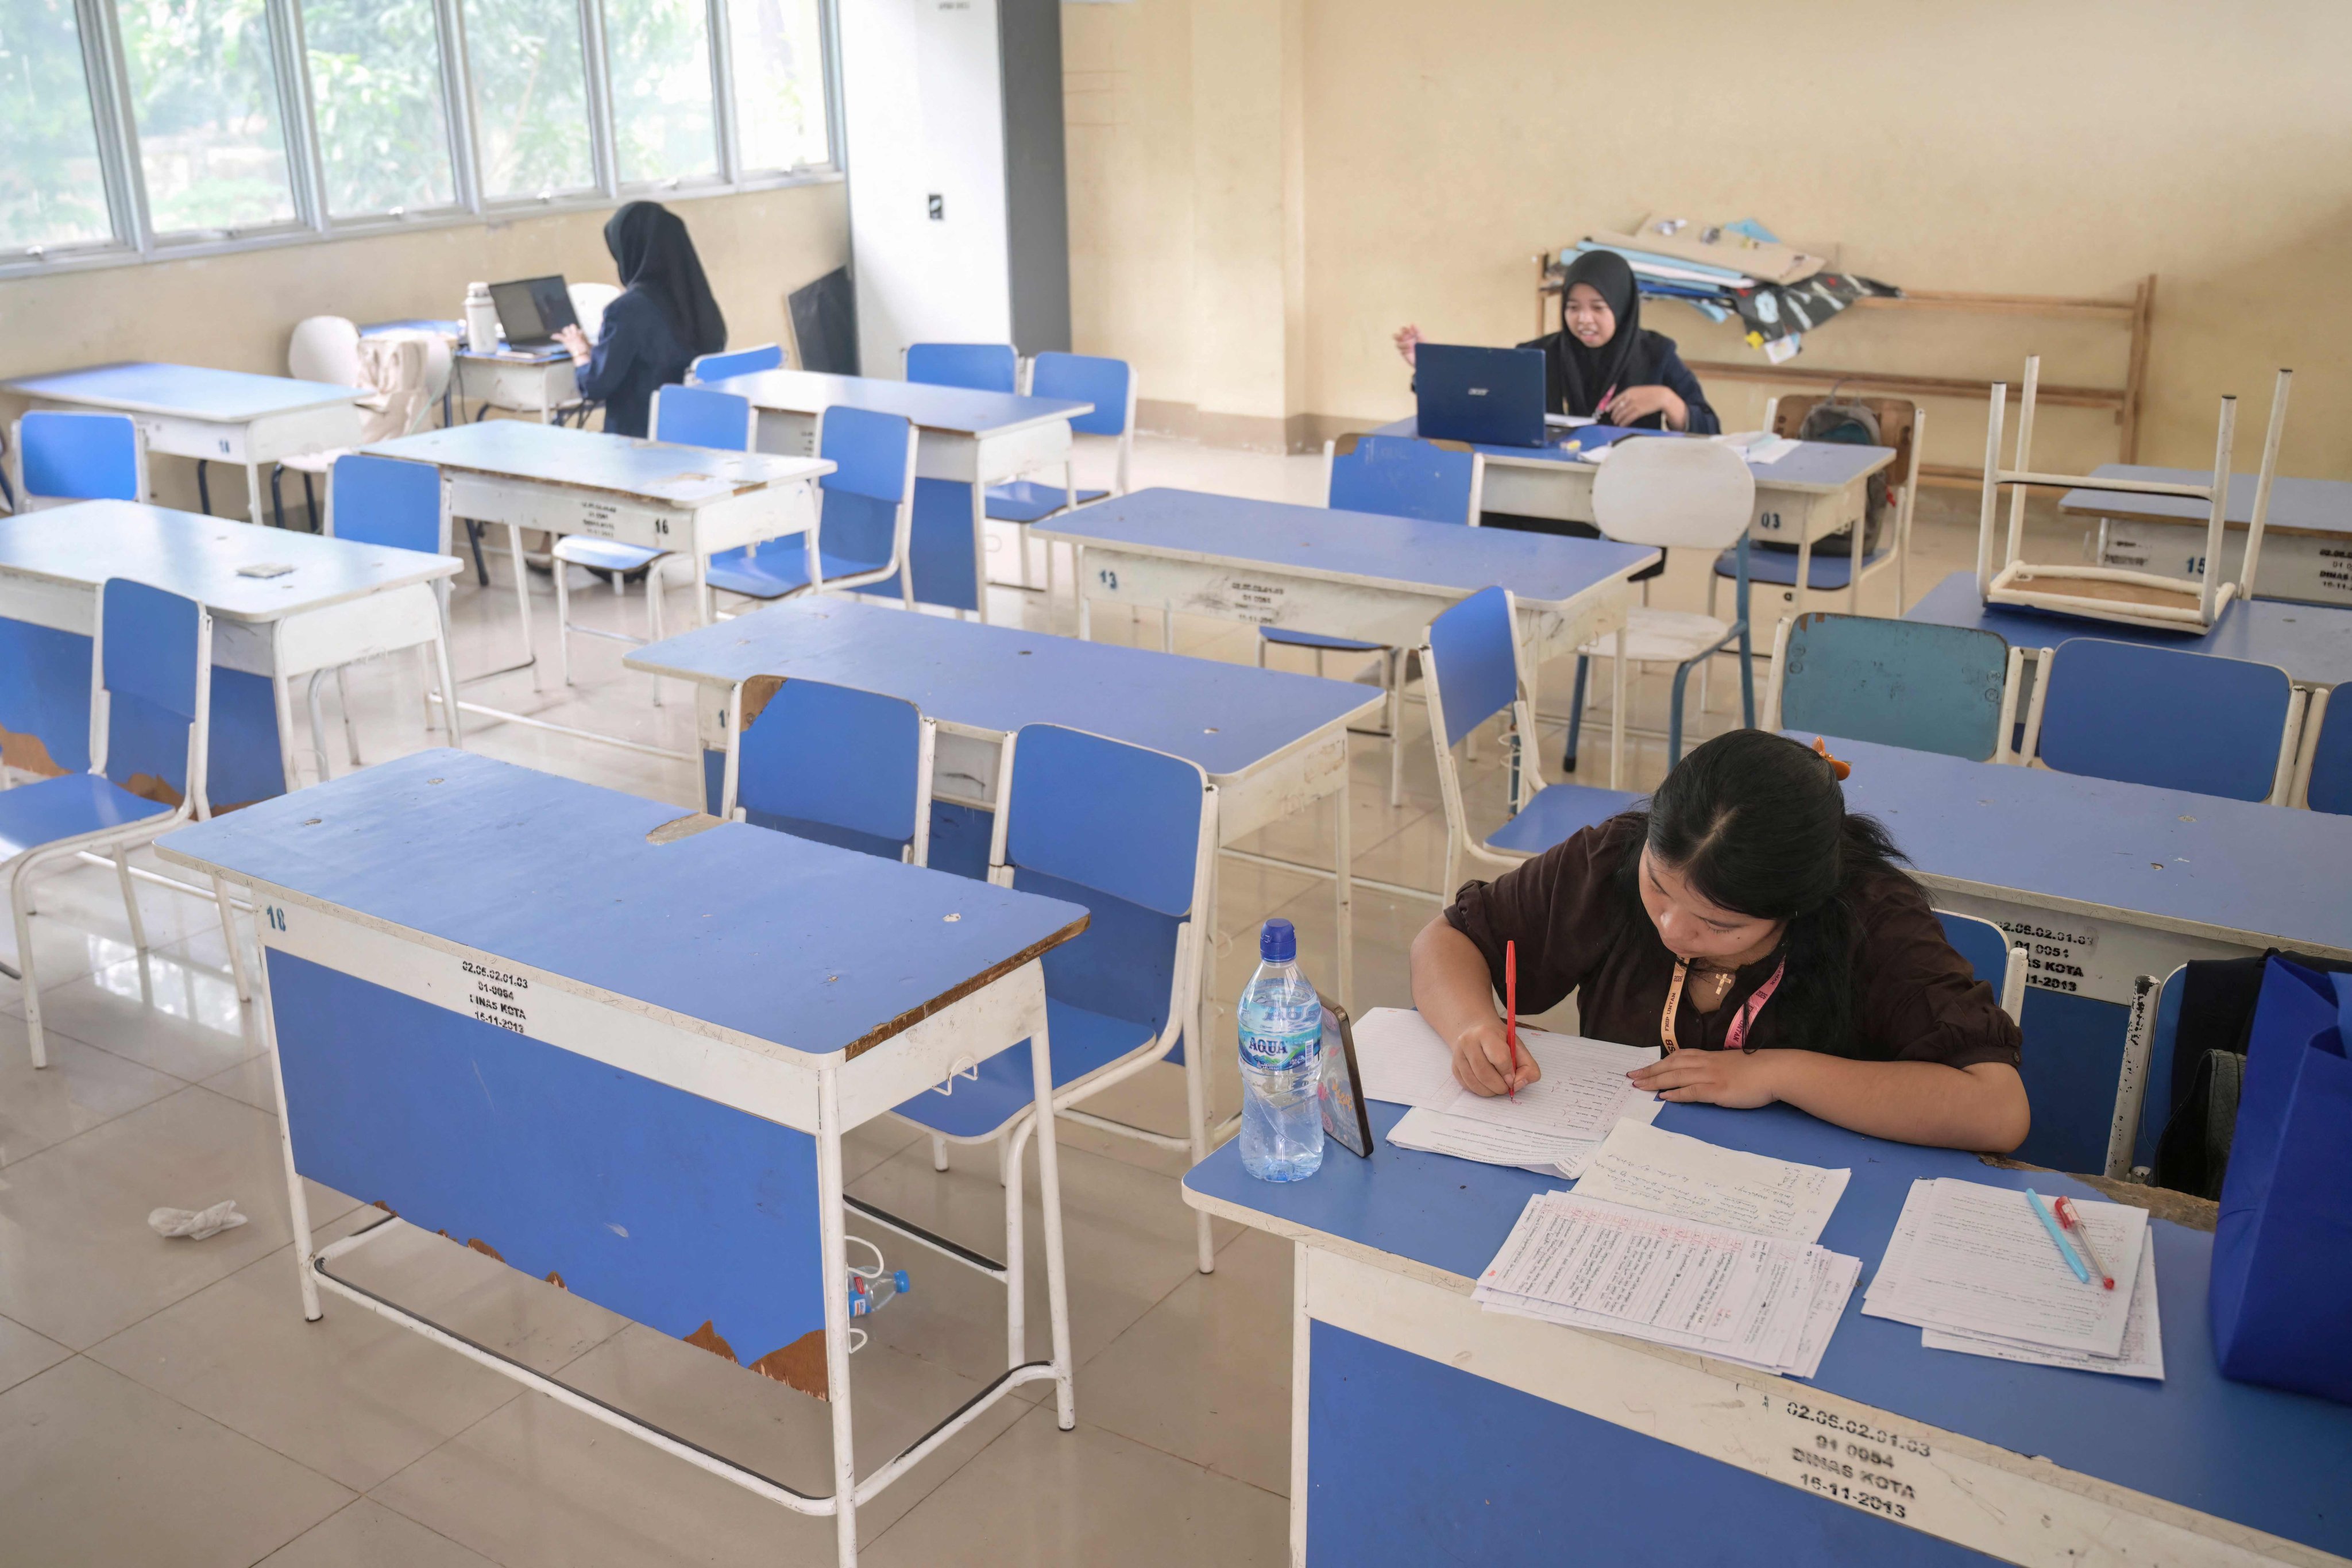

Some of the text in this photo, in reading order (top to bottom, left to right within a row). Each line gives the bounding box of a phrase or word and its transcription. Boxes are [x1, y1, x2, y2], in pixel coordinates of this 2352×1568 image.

[655, 519, 669, 534] 16
[2187, 557, 2205, 574] 15
[1099, 570, 1117, 589] 13
[719, 709, 725, 728] 1
[2045, 961, 2084, 977] KOTA
[500, 1003, 527, 1019] KOTA
[1667, 992, 1676, 1015] UNTAN
[1249, 1037, 1288, 1056] AQUA
[1816, 1434, 1838, 1451] 01
[1792, 1447, 1915, 1499] DINAS KOTA
